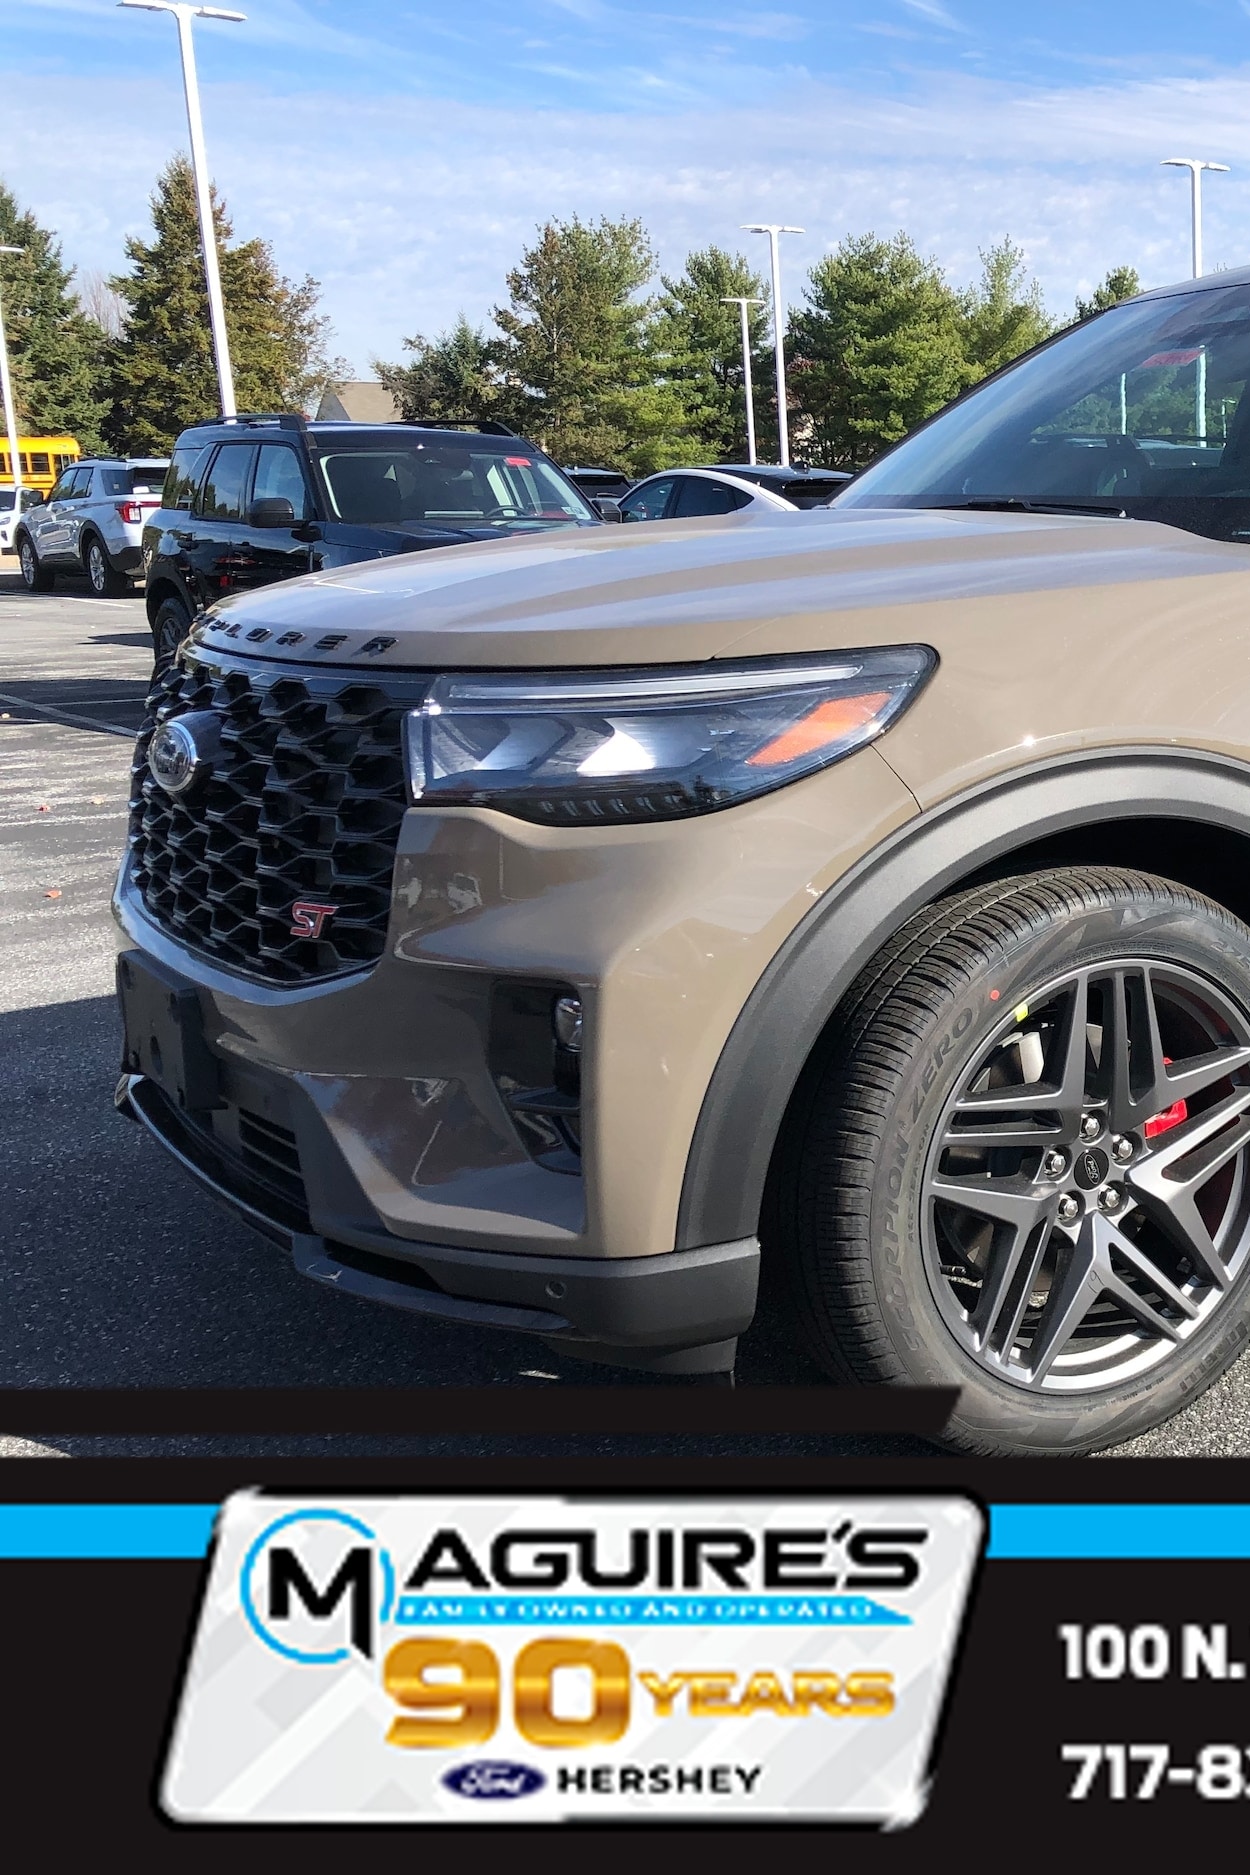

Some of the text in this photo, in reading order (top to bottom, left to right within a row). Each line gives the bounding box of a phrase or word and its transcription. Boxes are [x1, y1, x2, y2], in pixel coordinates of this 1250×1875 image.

[290, 901, 340, 938] ST
[882, 1007, 973, 1351] SCORPION ZERO
